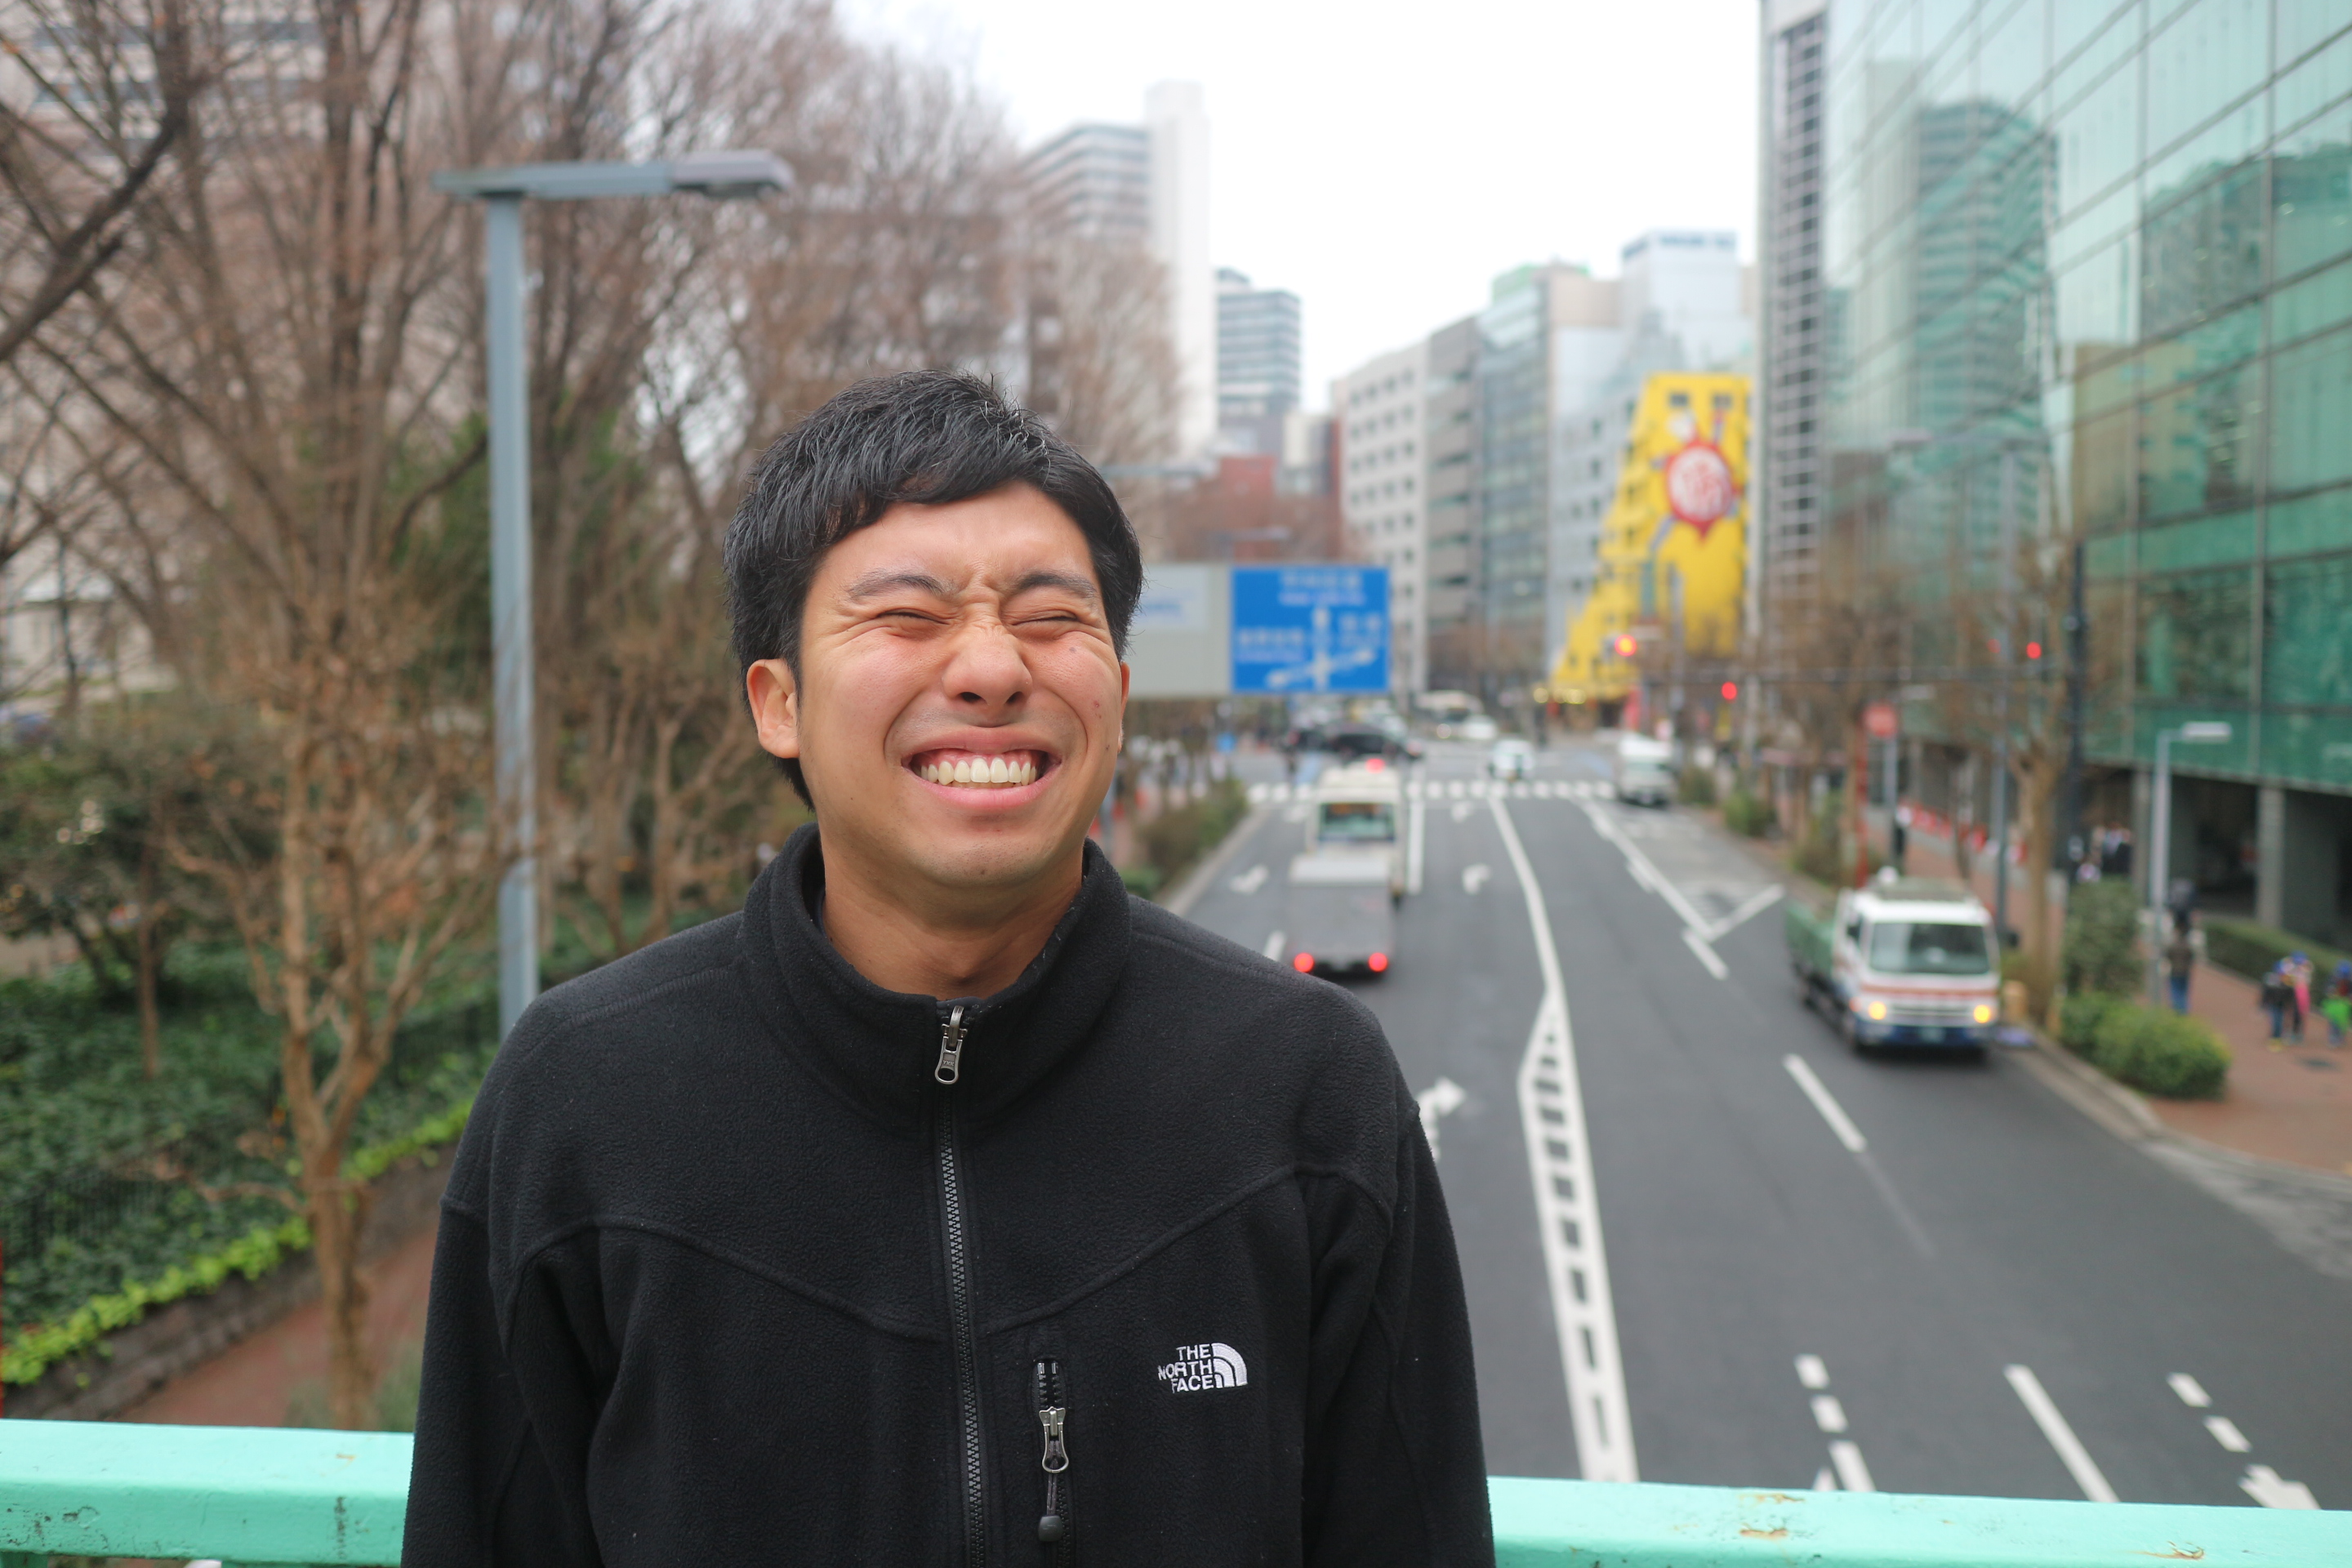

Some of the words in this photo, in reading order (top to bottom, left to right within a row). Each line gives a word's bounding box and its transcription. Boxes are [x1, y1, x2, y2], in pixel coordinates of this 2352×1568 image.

[1176, 1343, 1211, 1361] THE
[1157, 1358, 1213, 1380] NORTH
[1170, 1374, 1214, 1394] FACE
